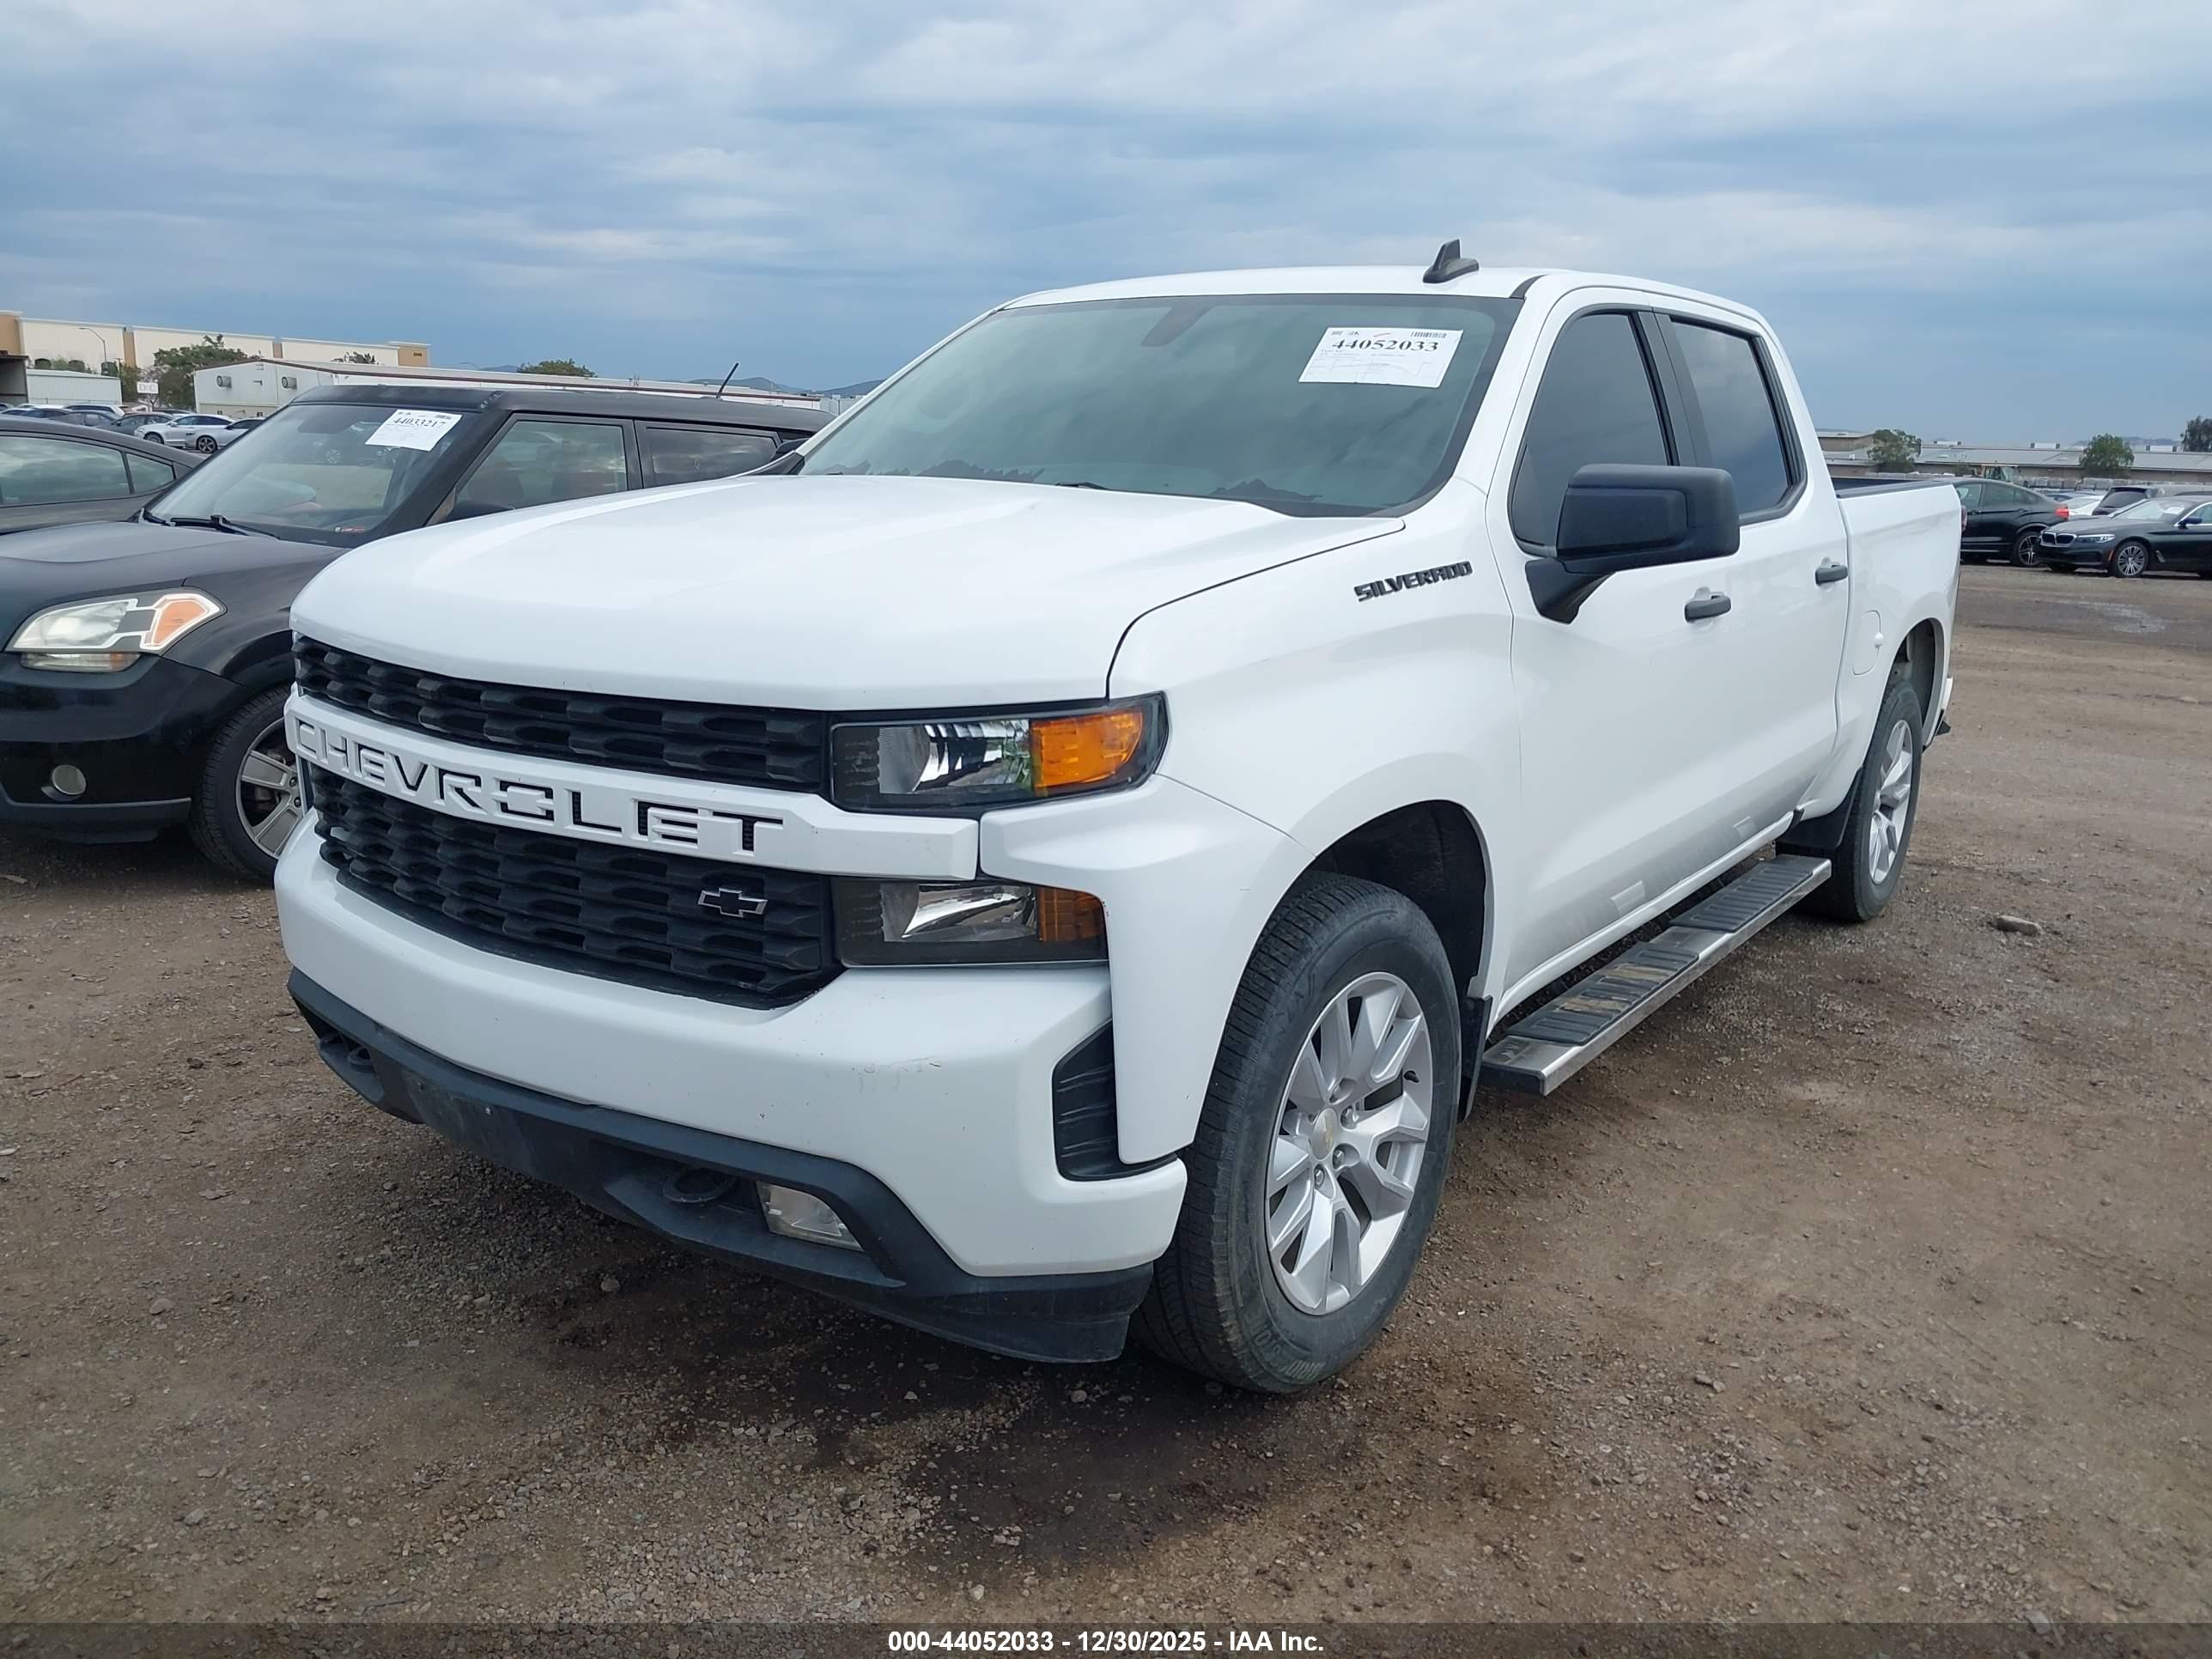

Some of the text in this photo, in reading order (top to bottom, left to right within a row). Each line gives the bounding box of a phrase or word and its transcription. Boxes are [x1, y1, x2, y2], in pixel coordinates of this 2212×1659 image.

[1332, 339, 1440, 352] 44052033
[392, 417, 447, 428] 44033217
[1353, 561, 1474, 603] SILVERADO
[295, 717, 784, 853] CHEVROLET
